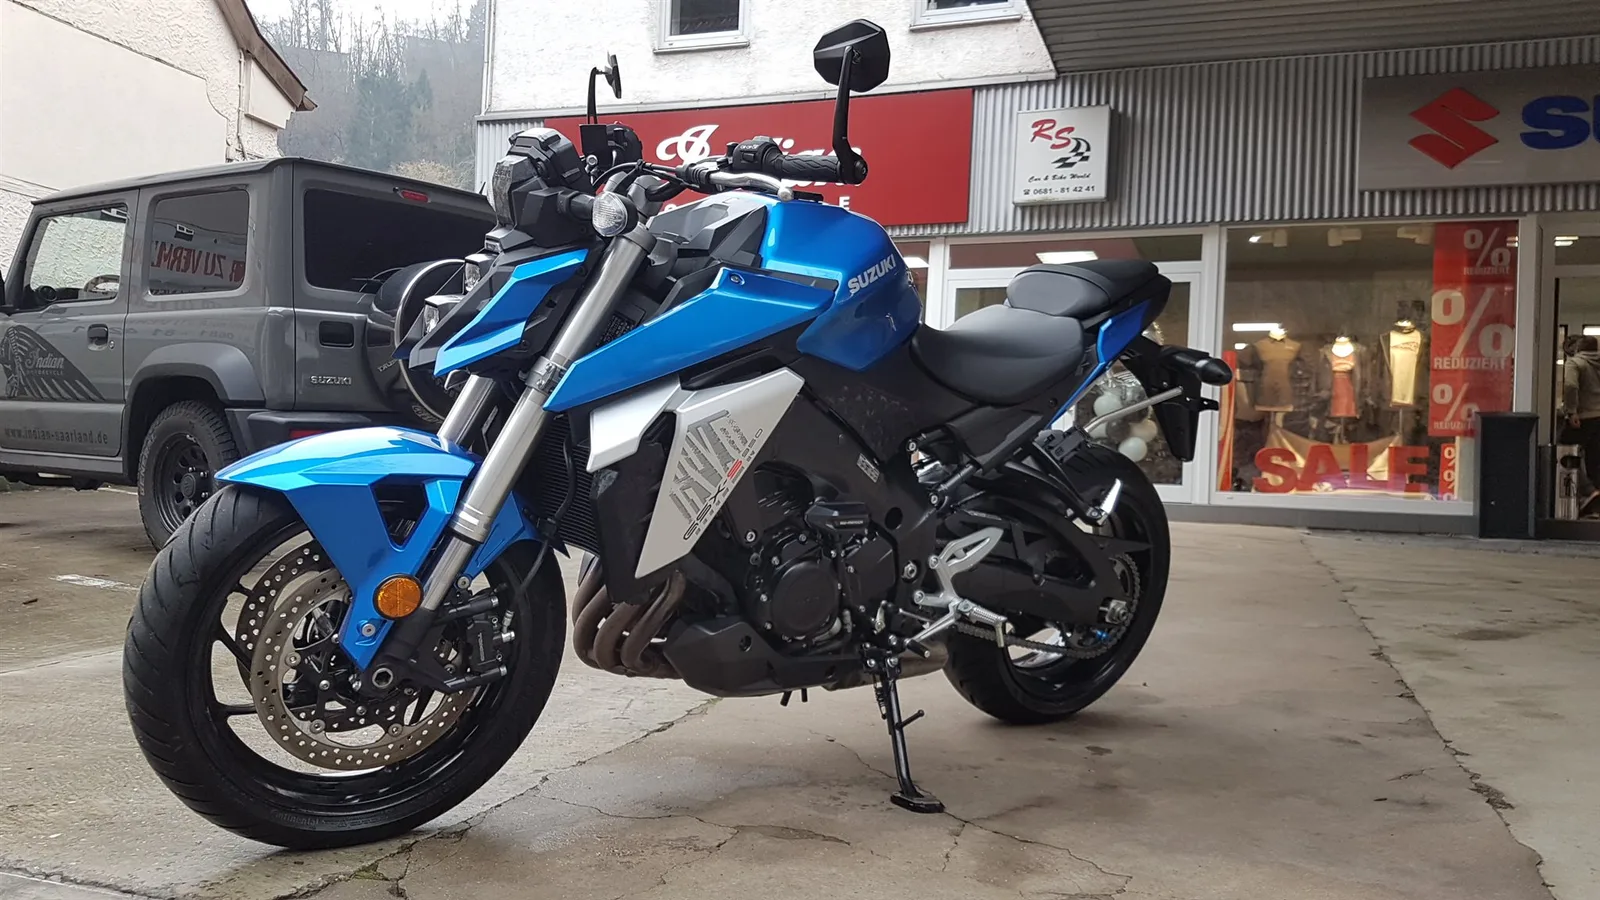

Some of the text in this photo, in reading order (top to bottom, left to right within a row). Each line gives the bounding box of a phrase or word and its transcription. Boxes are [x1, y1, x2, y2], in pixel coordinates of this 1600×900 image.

[1519, 94, 1600, 150] S
[1030, 118, 1075, 150] RS
[1033, 187, 1053, 195] 0681
[1060, 186, 1070, 194] 81
[1072, 185, 1083, 193] 42
[847, 253, 897, 294] SUZUKI
[1463, 266, 1509, 275] REDUZIERT
[24, 347, 65, 369] Indian
[1433, 356, 1507, 370] REDUZIERT
[310, 375, 352, 385] SUZUKI
[4, 426, 109, 445] www.indian-saarland.de
[1252, 442, 1430, 493] SALE
